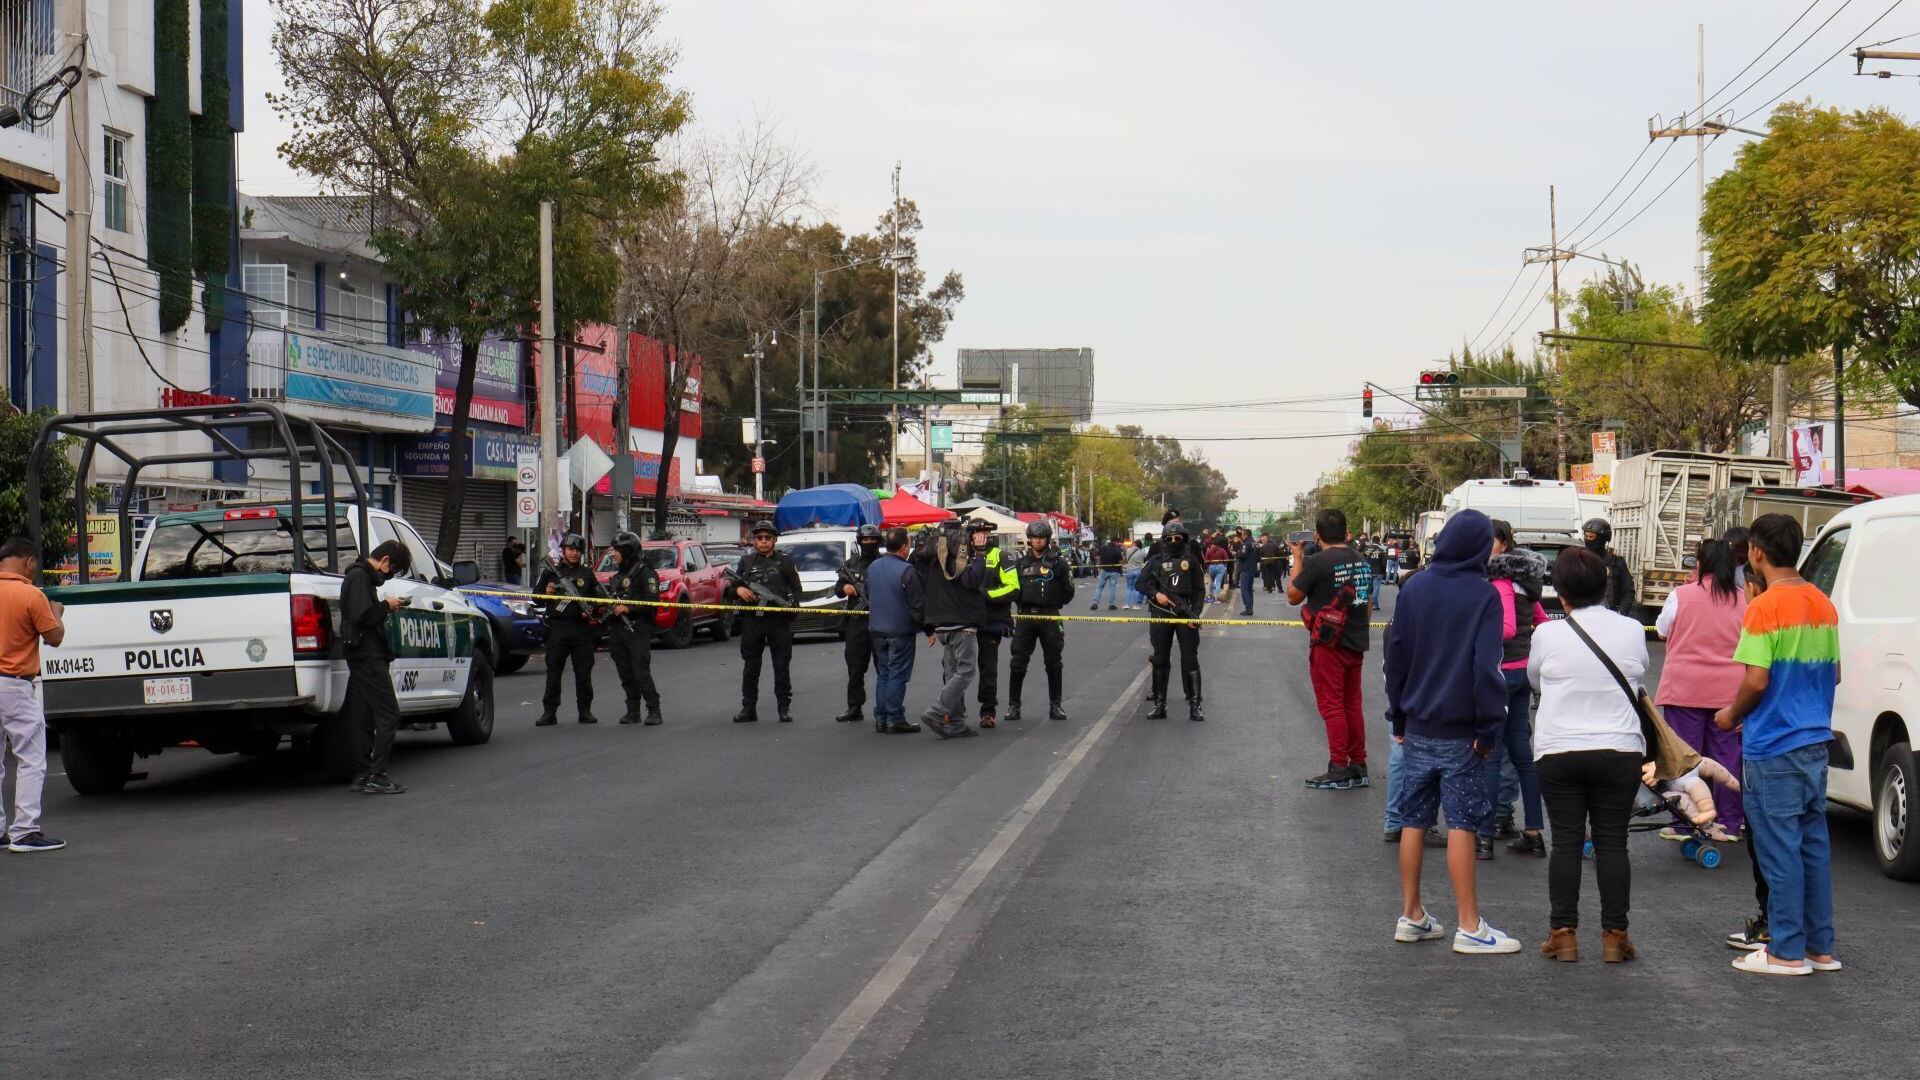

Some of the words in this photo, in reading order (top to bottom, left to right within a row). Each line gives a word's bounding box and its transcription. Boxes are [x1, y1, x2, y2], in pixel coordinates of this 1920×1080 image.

[306, 345, 381, 378] ESPECIALIDADES
[404, 452, 440, 461] SEGUNDA
[418, 441, 450, 450] EMPEÑO
[486, 441, 505, 461] CASA
[506, 443, 515, 463] DE
[400, 617, 441, 648] POLICIA
[46, 657, 95, 675] MX-014-E3
[125, 647, 205, 670] POLICIA
[145, 683, 190, 697] MX-014-E3
[401, 670, 419, 692] SSC
